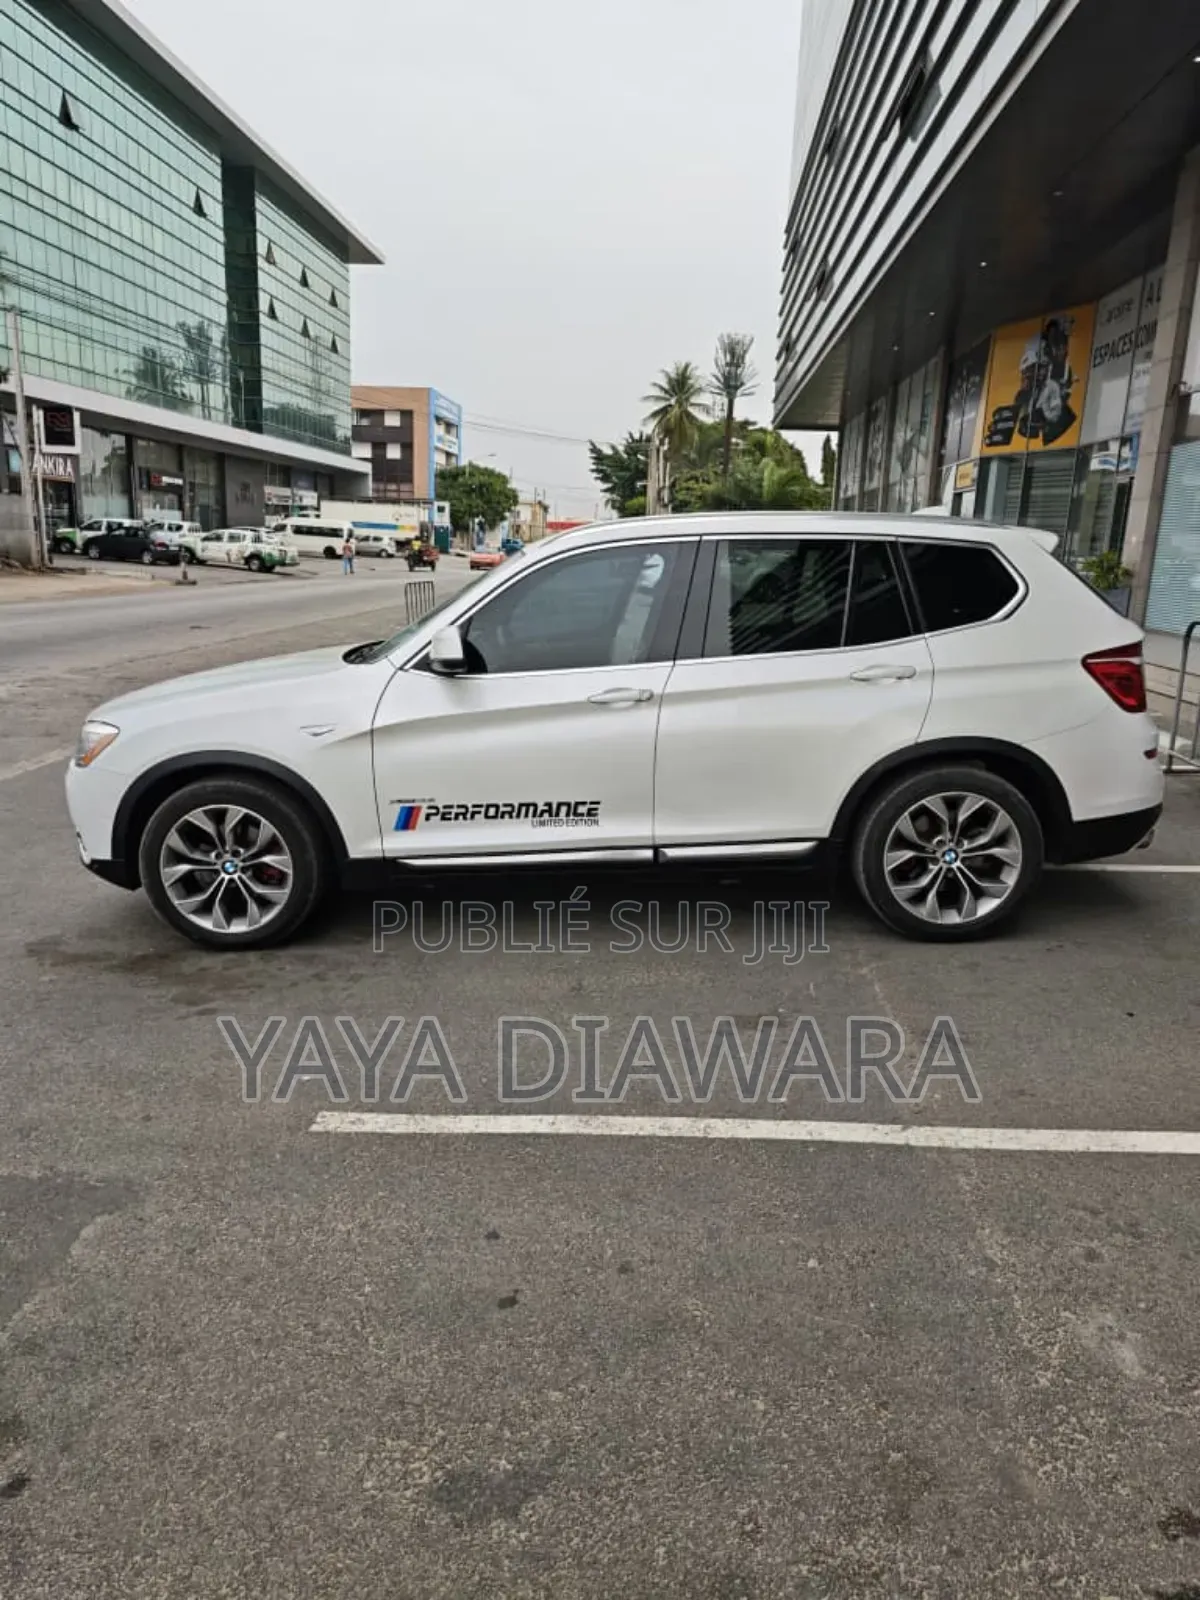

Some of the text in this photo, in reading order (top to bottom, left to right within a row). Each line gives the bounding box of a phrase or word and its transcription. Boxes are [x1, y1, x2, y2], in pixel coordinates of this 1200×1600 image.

[1092, 329, 1134, 368] ESPACES
[424, 801, 601, 822] PERFORMANCE
[531, 818, 600, 828] LIMITED EDITION
